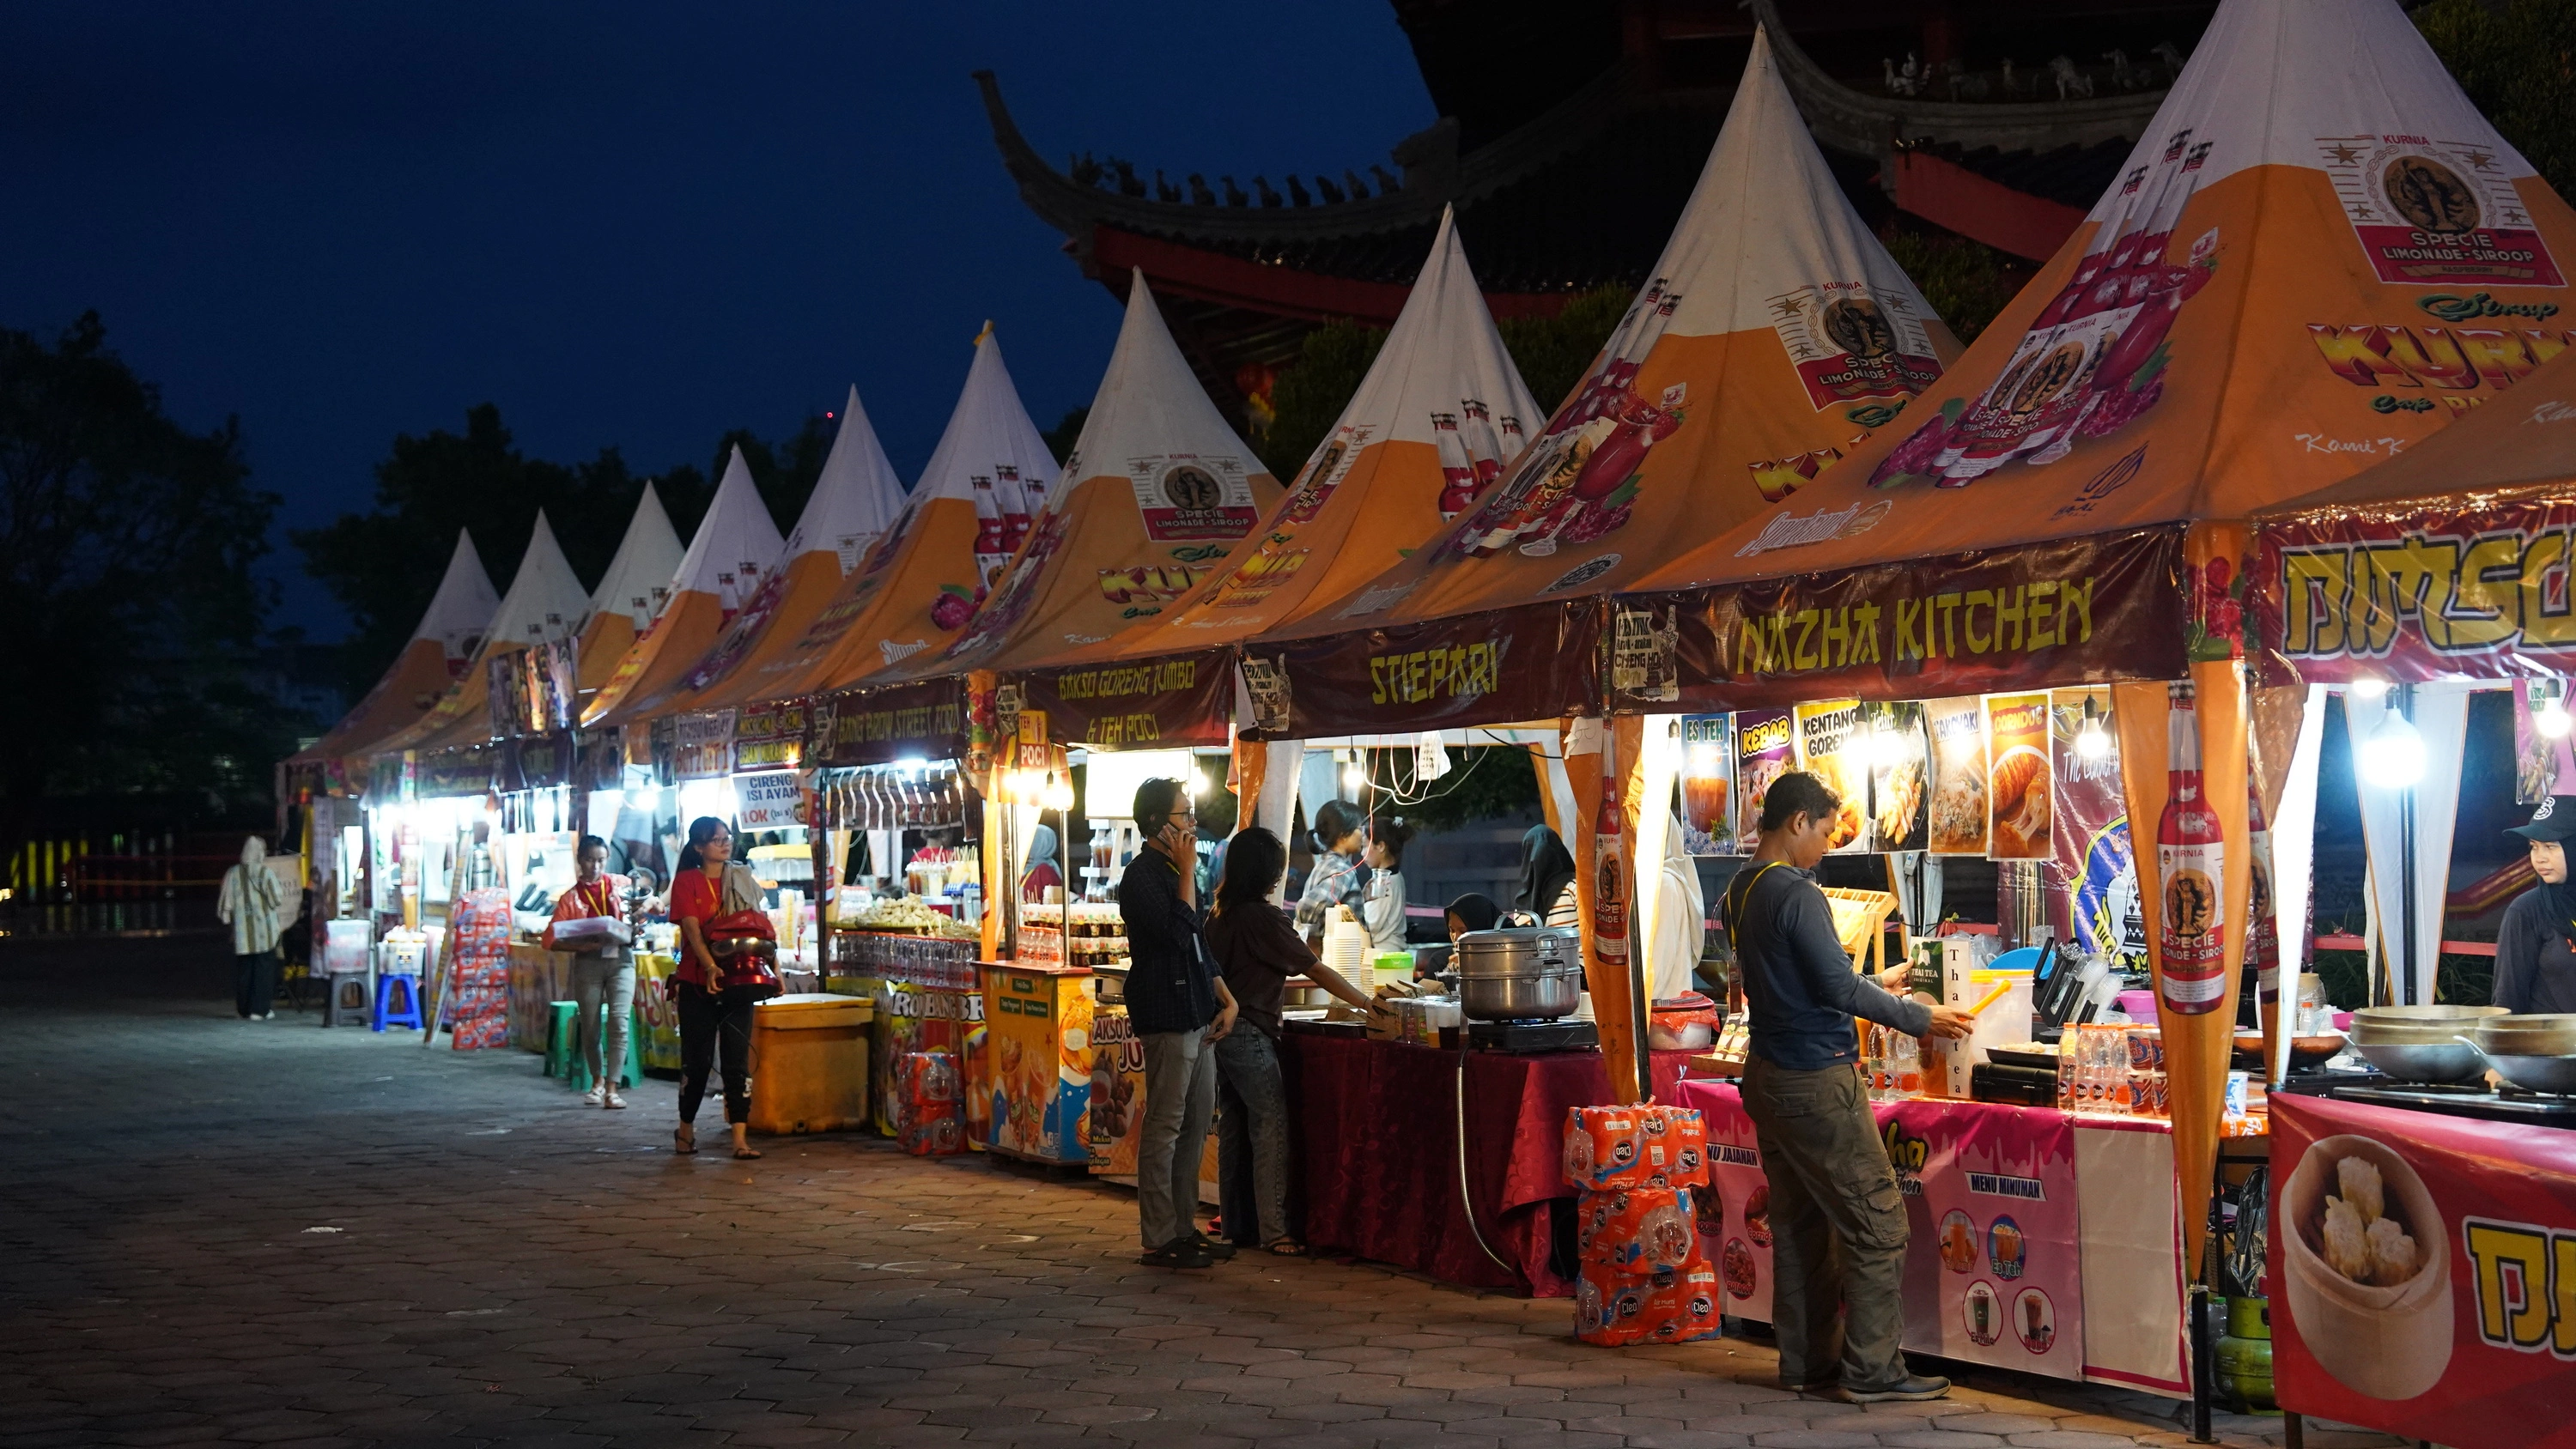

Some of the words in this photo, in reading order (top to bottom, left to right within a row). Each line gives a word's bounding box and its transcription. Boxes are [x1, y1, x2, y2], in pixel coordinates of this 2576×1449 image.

[2383, 135, 2430, 146] KURNIA
[2411, 232, 2494, 247] SPECIE
[1823, 281, 1862, 292] KURNIA
[2416, 292, 2560, 322] Sirup
[2066, 318, 2097, 333] KURNIA
[1844, 353, 1906, 369] SPECIE
[2369, 395, 2435, 414] Cap
[1996, 408, 2043, 428] SPECIE
[2295, 433, 2376, 454] Kami
[1176, 509, 1225, 518] SPECIE
[1737, 600, 1885, 676] NAZHA
[1896, 577, 2095, 660] KITCHEN
[1615, 652, 1646, 669] CHENG
[1059, 670, 1096, 700] BAKSO
[1097, 666, 1151, 698] GORENG
[1152, 659, 1196, 696] JUMBO
[1370, 641, 1498, 705] STIEPARI
[895, 706, 933, 739] STREET
[1019, 715, 1030, 730] TEH
[1933, 711, 1980, 743] TAKOYAKI
[1993, 706, 2044, 732] CORNDOG
[1086, 718, 1096, 743] &
[1100, 715, 1124, 744] TEH
[1126, 713, 1160, 742] POCI
[1686, 721, 1699, 742] ES
[1703, 719, 1723, 742] TEH
[1741, 718, 1790, 757] KEBAB
[1020, 745, 1045, 766] POCI
[2063, 746, 2081, 785] The
[750, 774, 793, 789] CIRENG
[747, 791, 763, 802] ISI
[767, 786, 800, 800] AYAM
[742, 809, 769, 824] 10K
[2167, 933, 2215, 949] SPECIE
[1911, 967, 1924, 977] THAI
[1924, 969, 1939, 978] TEA
[1949, 949, 1959, 1001] Tha
[1093, 1015, 1122, 1042] AKSO
[2076, 1087, 2087, 1095] Cleo
[1646, 1120, 1663, 1131] Cleo
[1616, 1146, 1631, 1156] Cleo
[1682, 1153, 1697, 1164] Cleo
[1707, 1144, 1721, 1161] NU
[1722, 1147, 1758, 1166] JAJANAN
[1971, 1174, 1997, 1193] MENU
[1999, 1177, 2040, 1198] MINUMAN
[1991, 1258, 2002, 1275] Es
[2003, 1260, 2023, 1278] Teh
[1655, 1274, 1673, 1284] Cleo
[1622, 1302, 1637, 1314] Cleo
[1693, 1303, 1709, 1313] Cleo
[1971, 1331, 1978, 1343] Es
